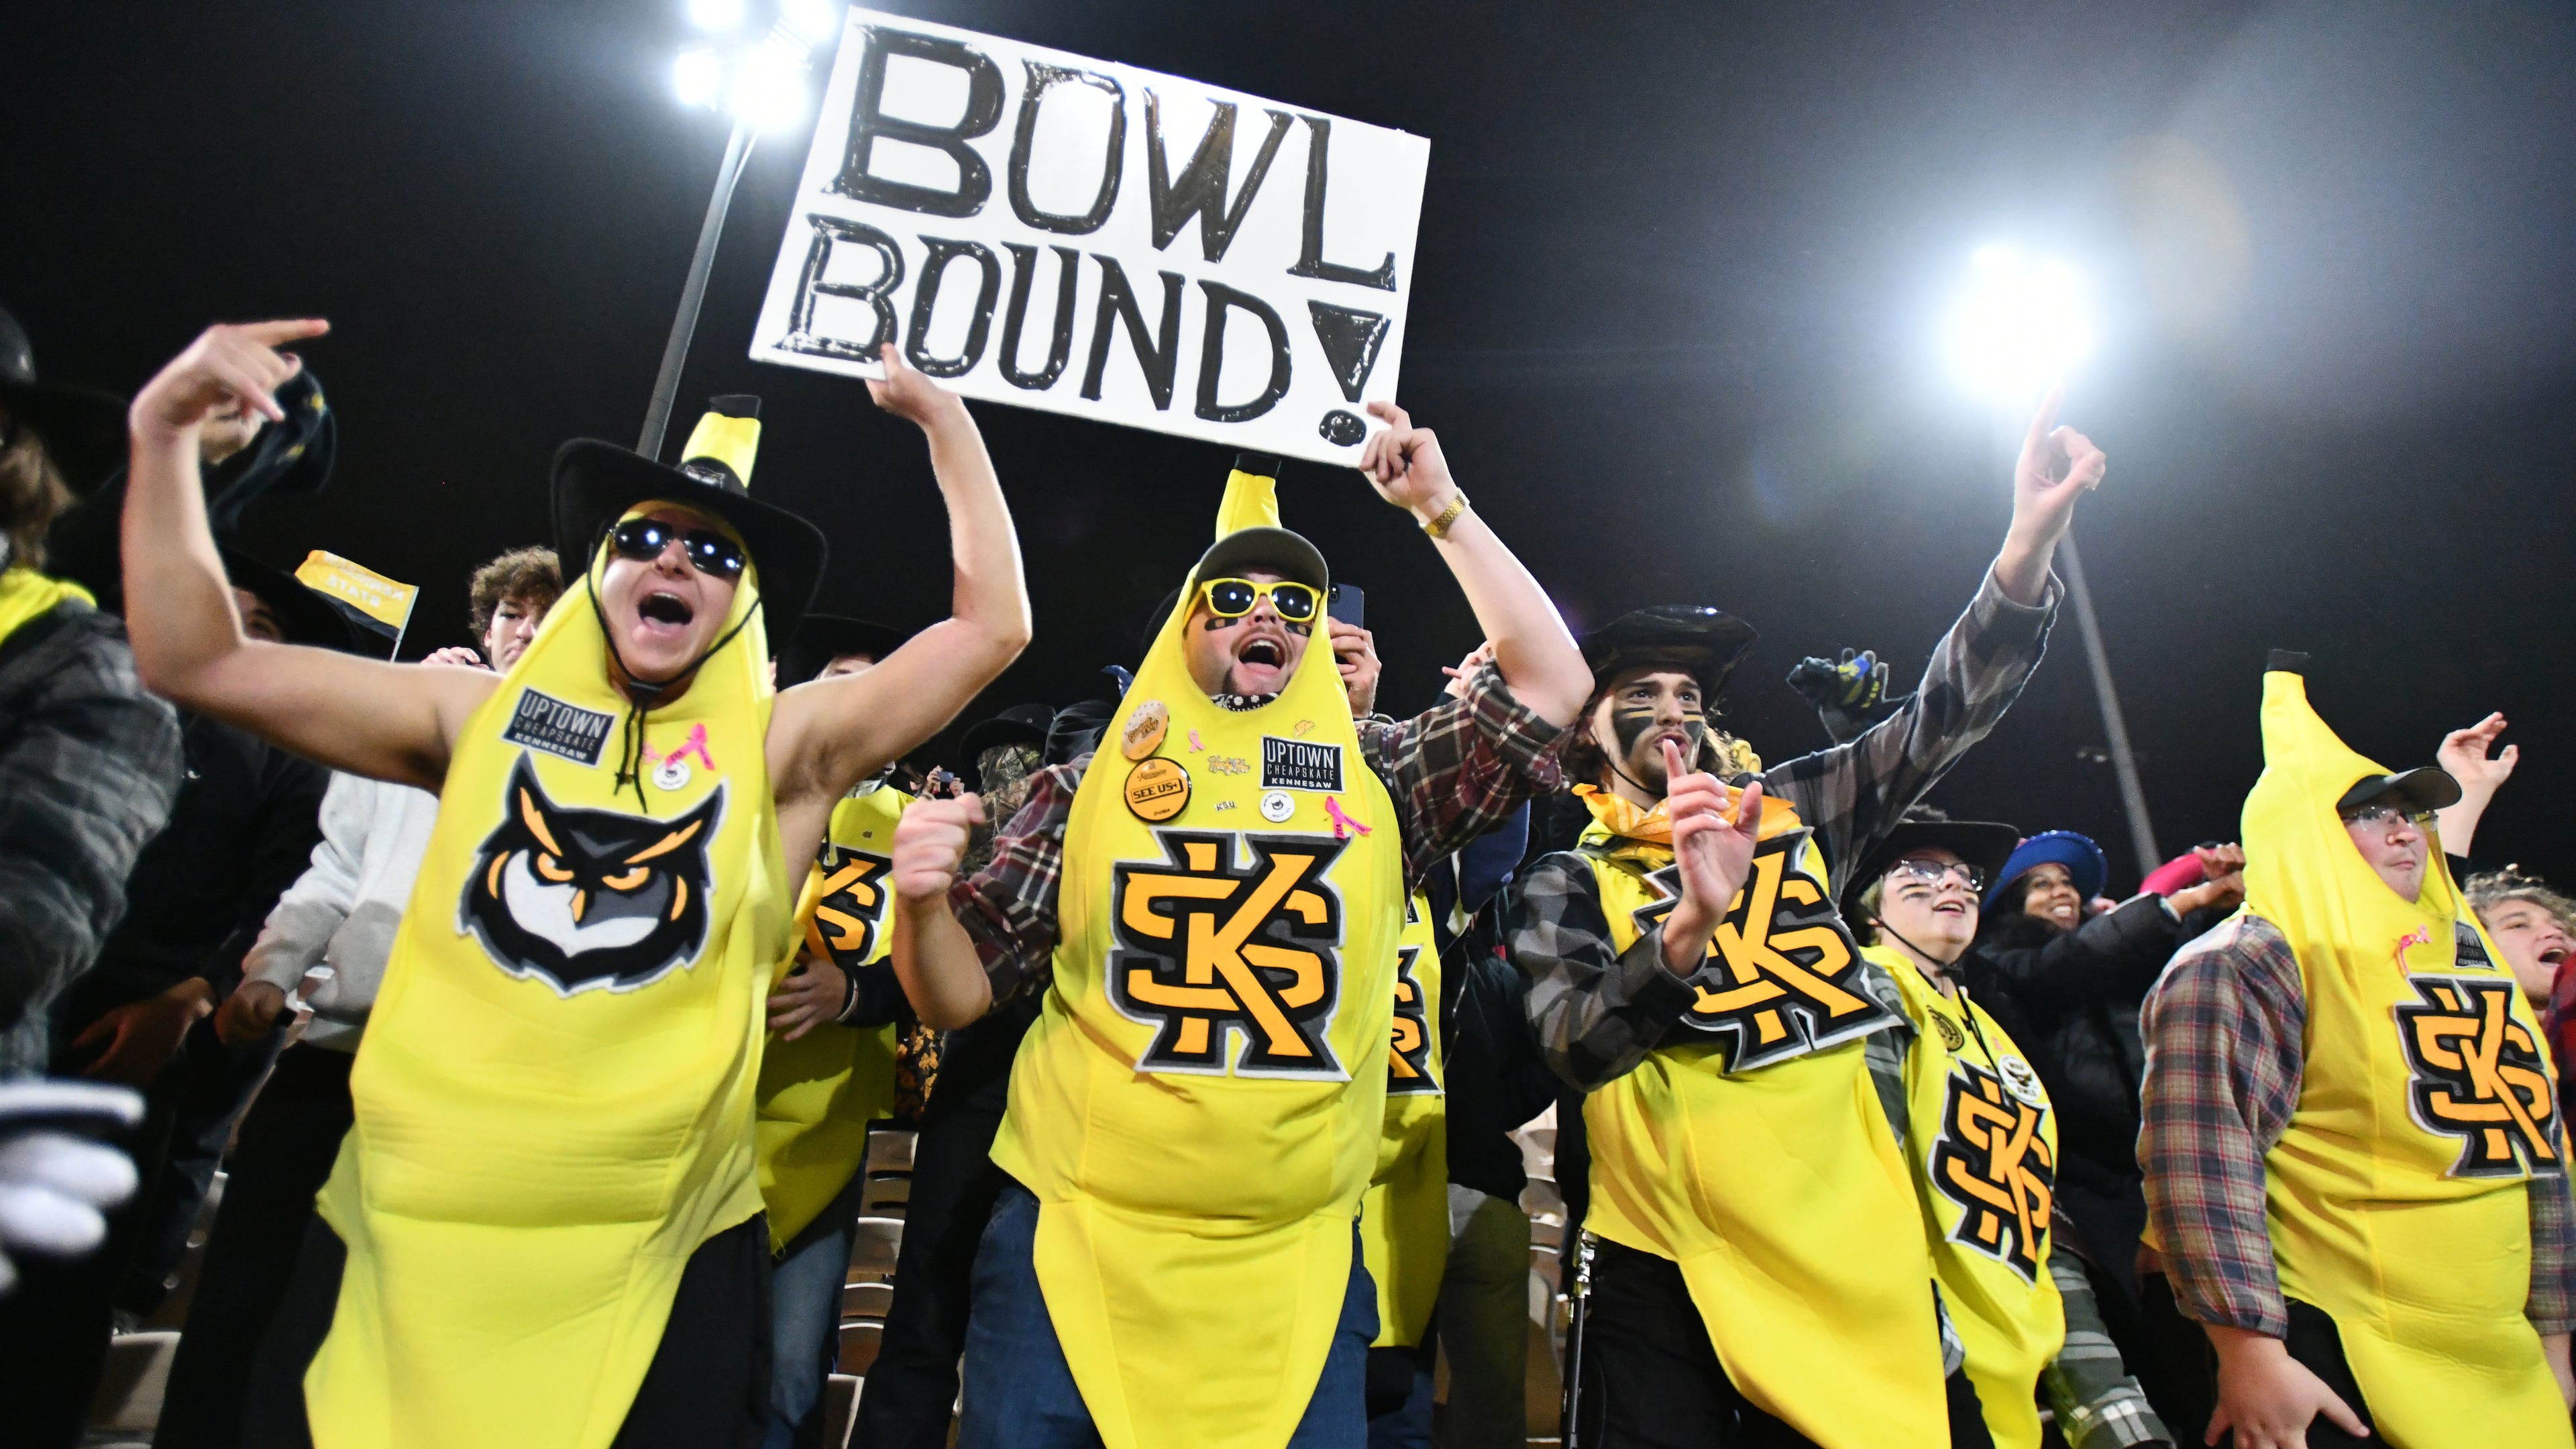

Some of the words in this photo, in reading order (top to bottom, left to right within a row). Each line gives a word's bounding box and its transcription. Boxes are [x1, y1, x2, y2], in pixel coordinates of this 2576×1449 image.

[820, 23, 1397, 293] BOWL
[520, 692, 608, 739] UPTOWN
[514, 716, 597, 751] CHEAPSKATE
[515, 732, 588, 760] KENNESAW
[1266, 739, 1335, 769] UPTOWN
[1267, 763, 1335, 780] CHEAPSKATE
[1271, 777, 1332, 789] KENNESAW
[1133, 786, 1156, 800] SEE
[1216, 800, 1236, 811] KSU
